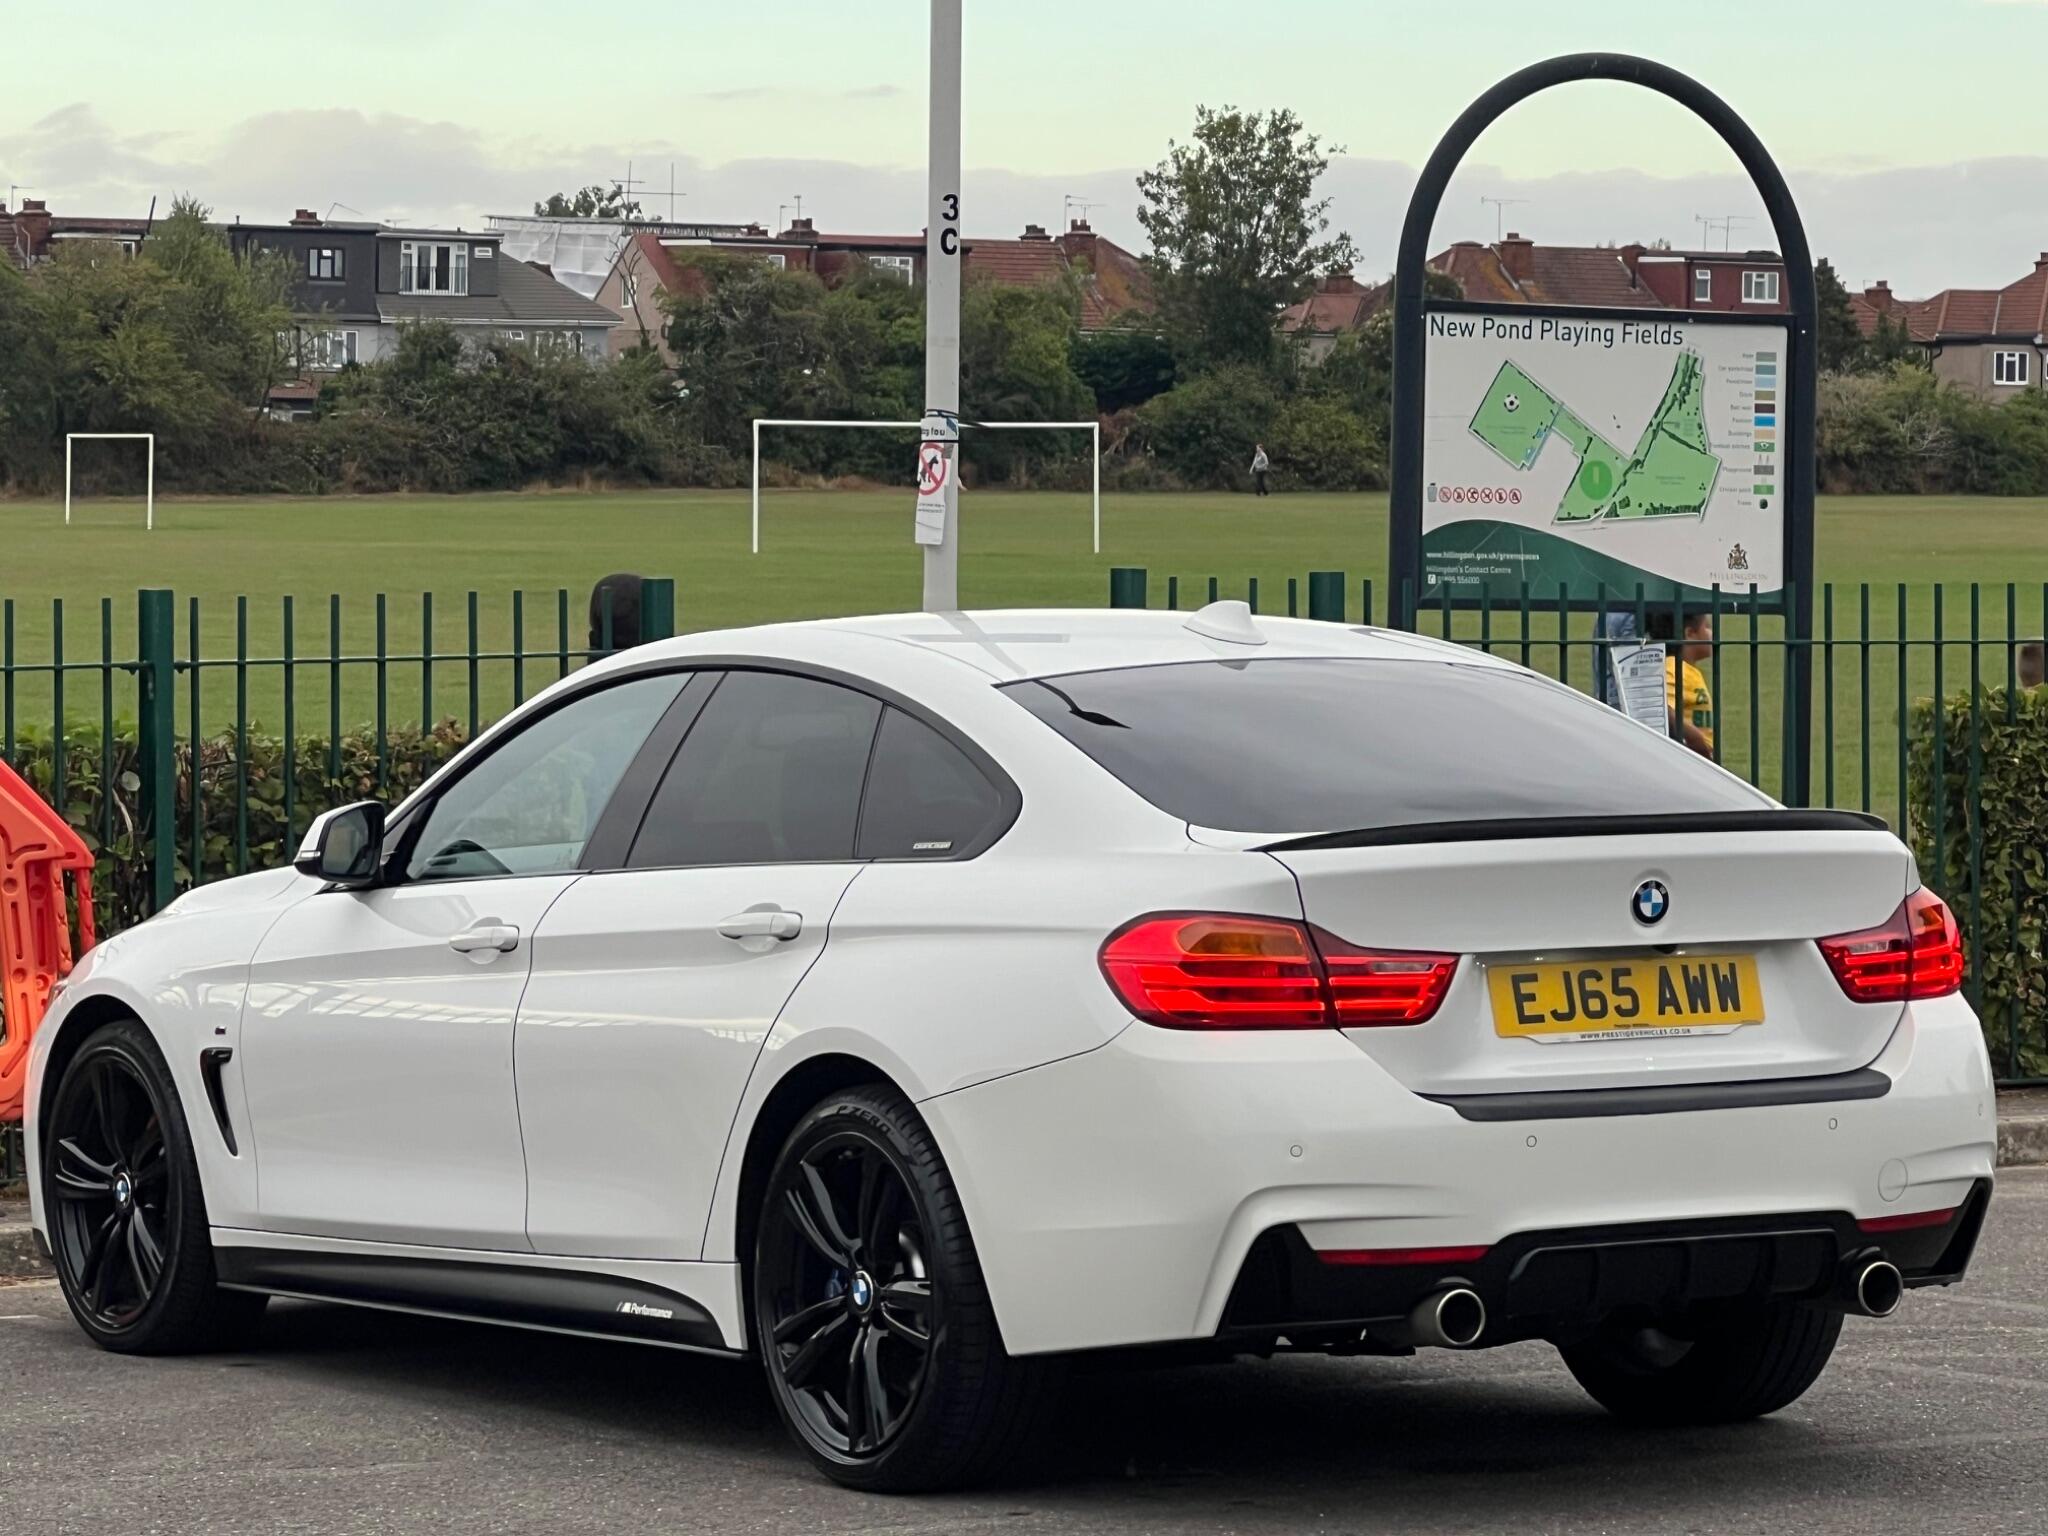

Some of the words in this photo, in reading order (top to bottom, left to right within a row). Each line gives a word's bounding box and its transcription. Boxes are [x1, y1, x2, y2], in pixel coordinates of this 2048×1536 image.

[1430, 315, 1475, 338] New
[1482, 317, 1532, 340] Pond
[1540, 319, 1612, 348] Playing
[1622, 322, 1683, 345] Fields
[1511, 967, 1641, 1025] EJ65
[1657, 961, 1742, 1016] AWW
